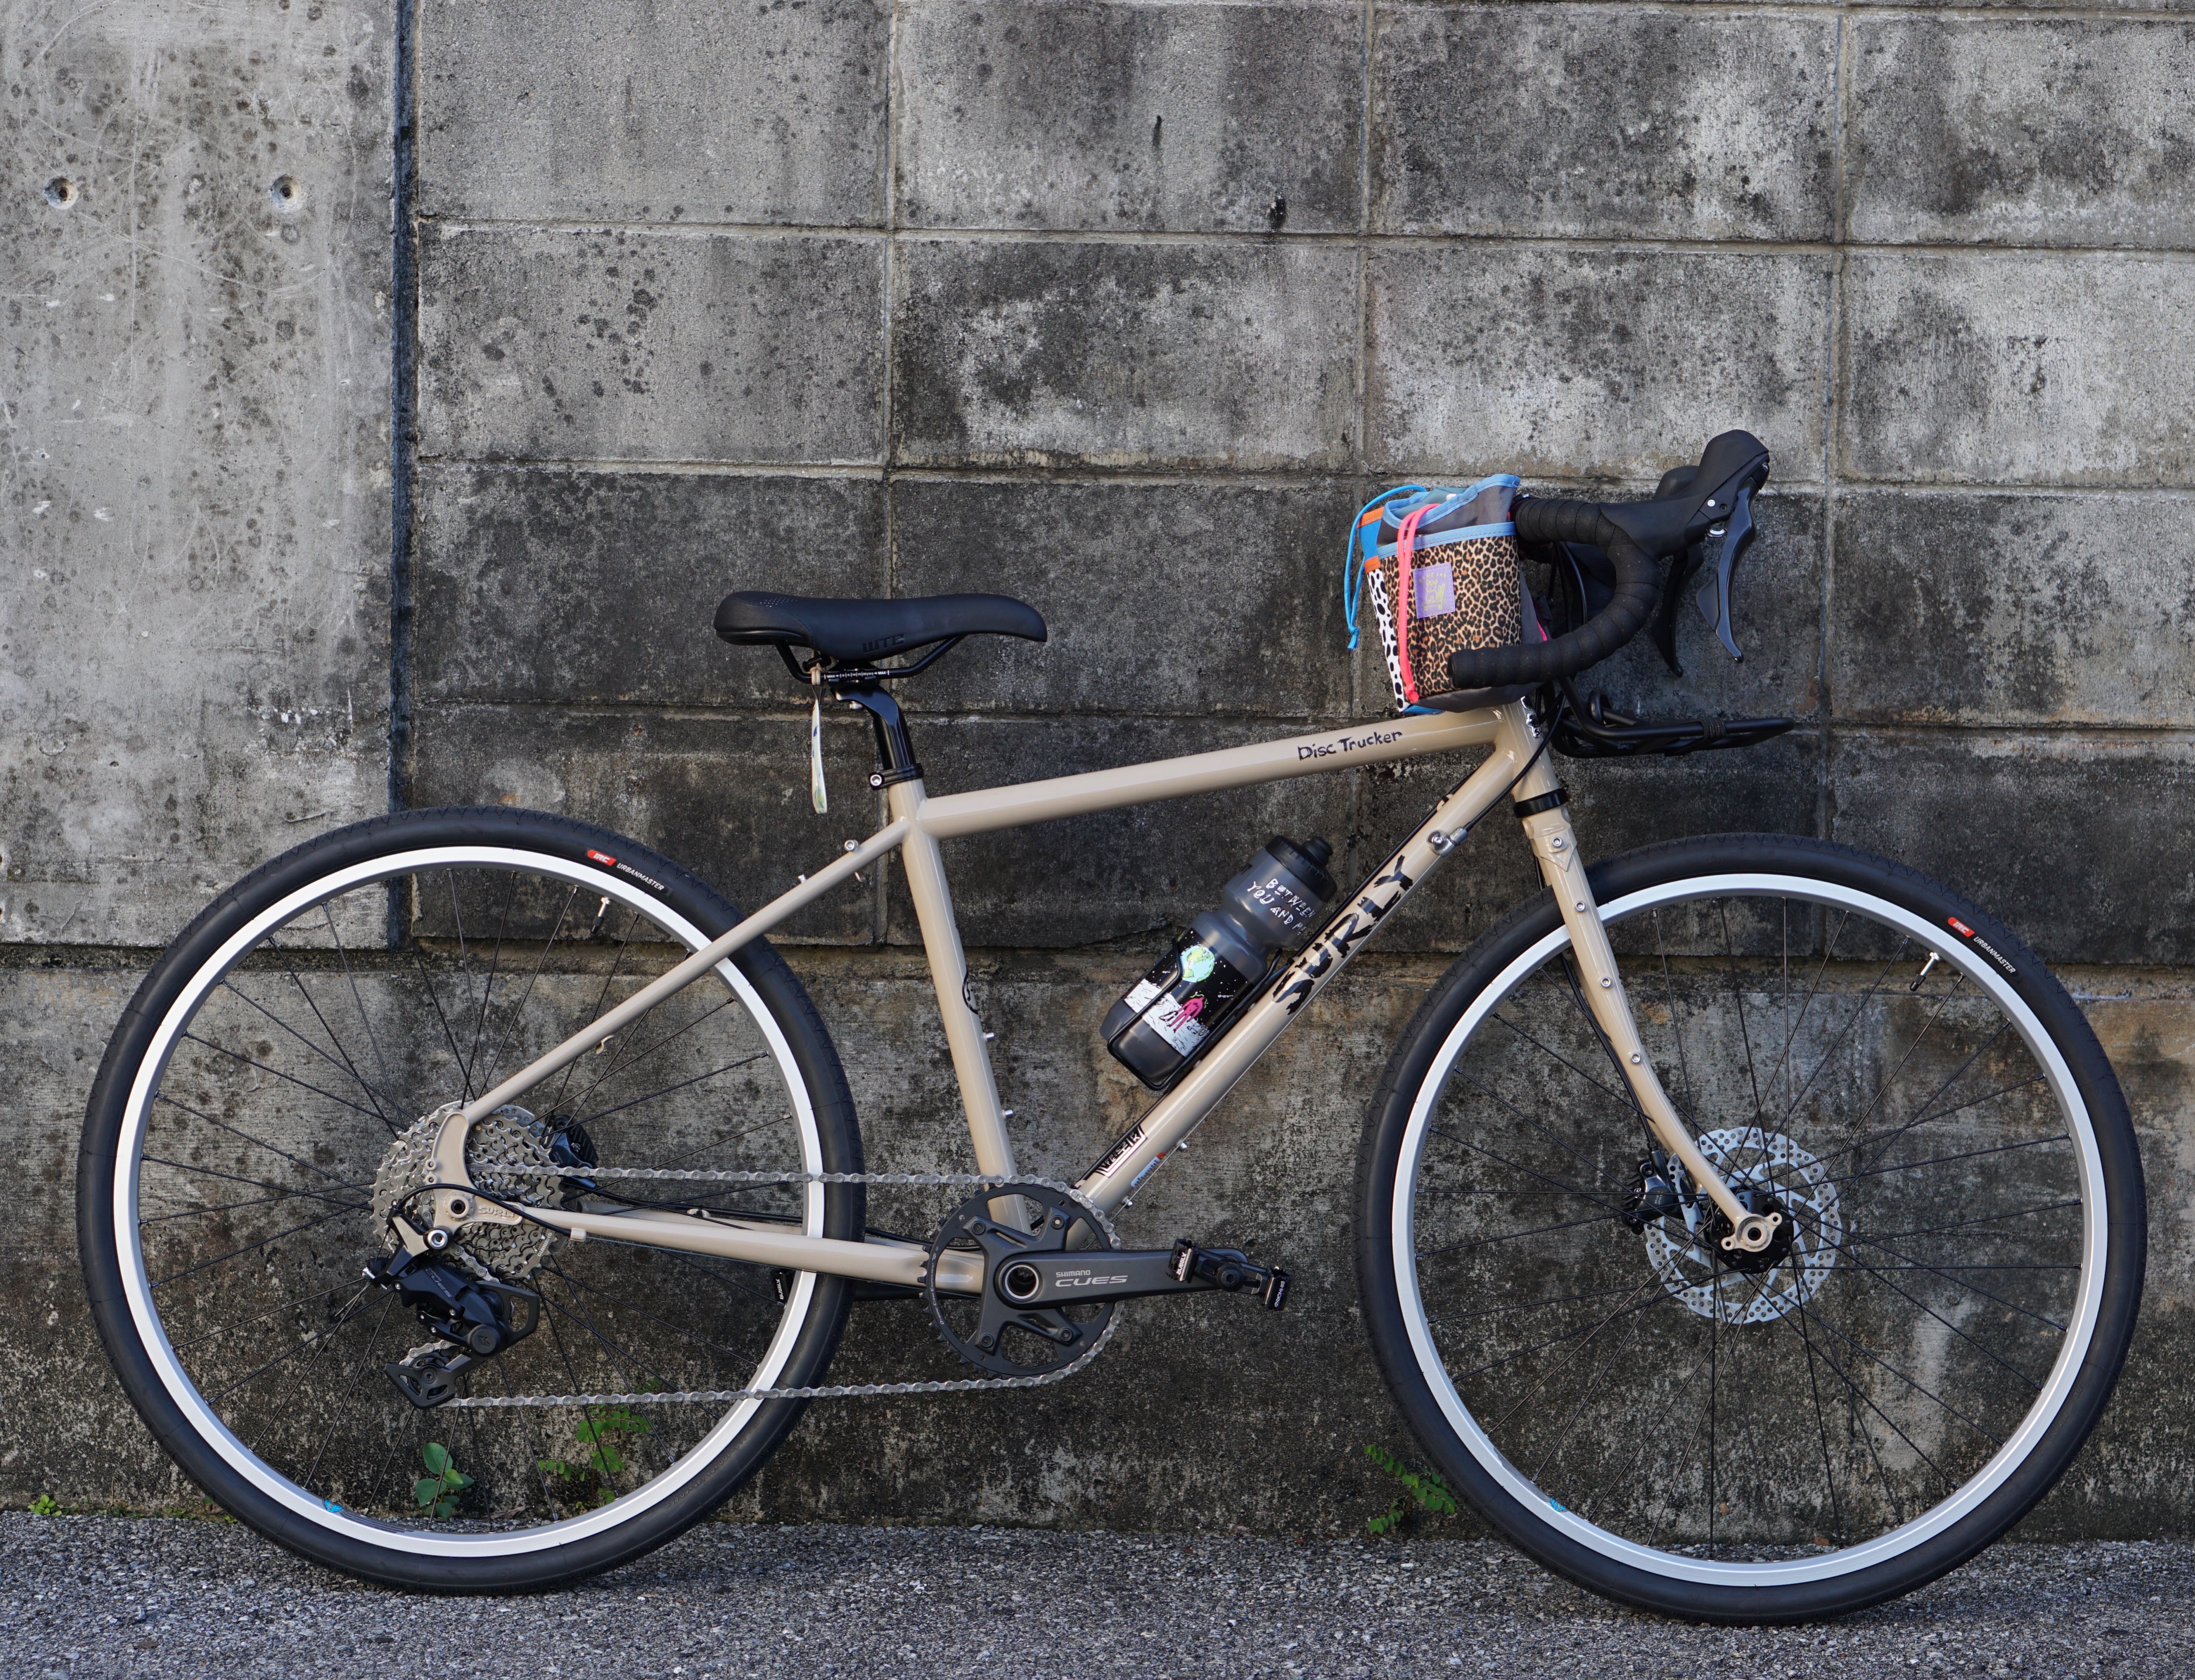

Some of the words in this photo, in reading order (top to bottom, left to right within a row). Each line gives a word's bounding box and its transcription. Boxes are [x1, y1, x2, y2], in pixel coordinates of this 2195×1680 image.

[1297, 743, 1337, 761] Disc
[1337, 732, 1403, 752] Trucker
[617, 862, 665, 891] URBANMASTER
[1247, 881, 1275, 904] YOU
[1270, 907, 1294, 925] AND
[1266, 878, 1315, 917] BETWEEN
[1272, 854, 1413, 1015] SURLY
[1973, 936, 2016, 973] URBANMASTER
[1056, 1270, 1091, 1278] SHIMANO
[1176, 1252, 1187, 1276] BUBBLY
[425, 1268, 452, 1297] CUES
[1055, 1275, 1128, 1287] CUES
